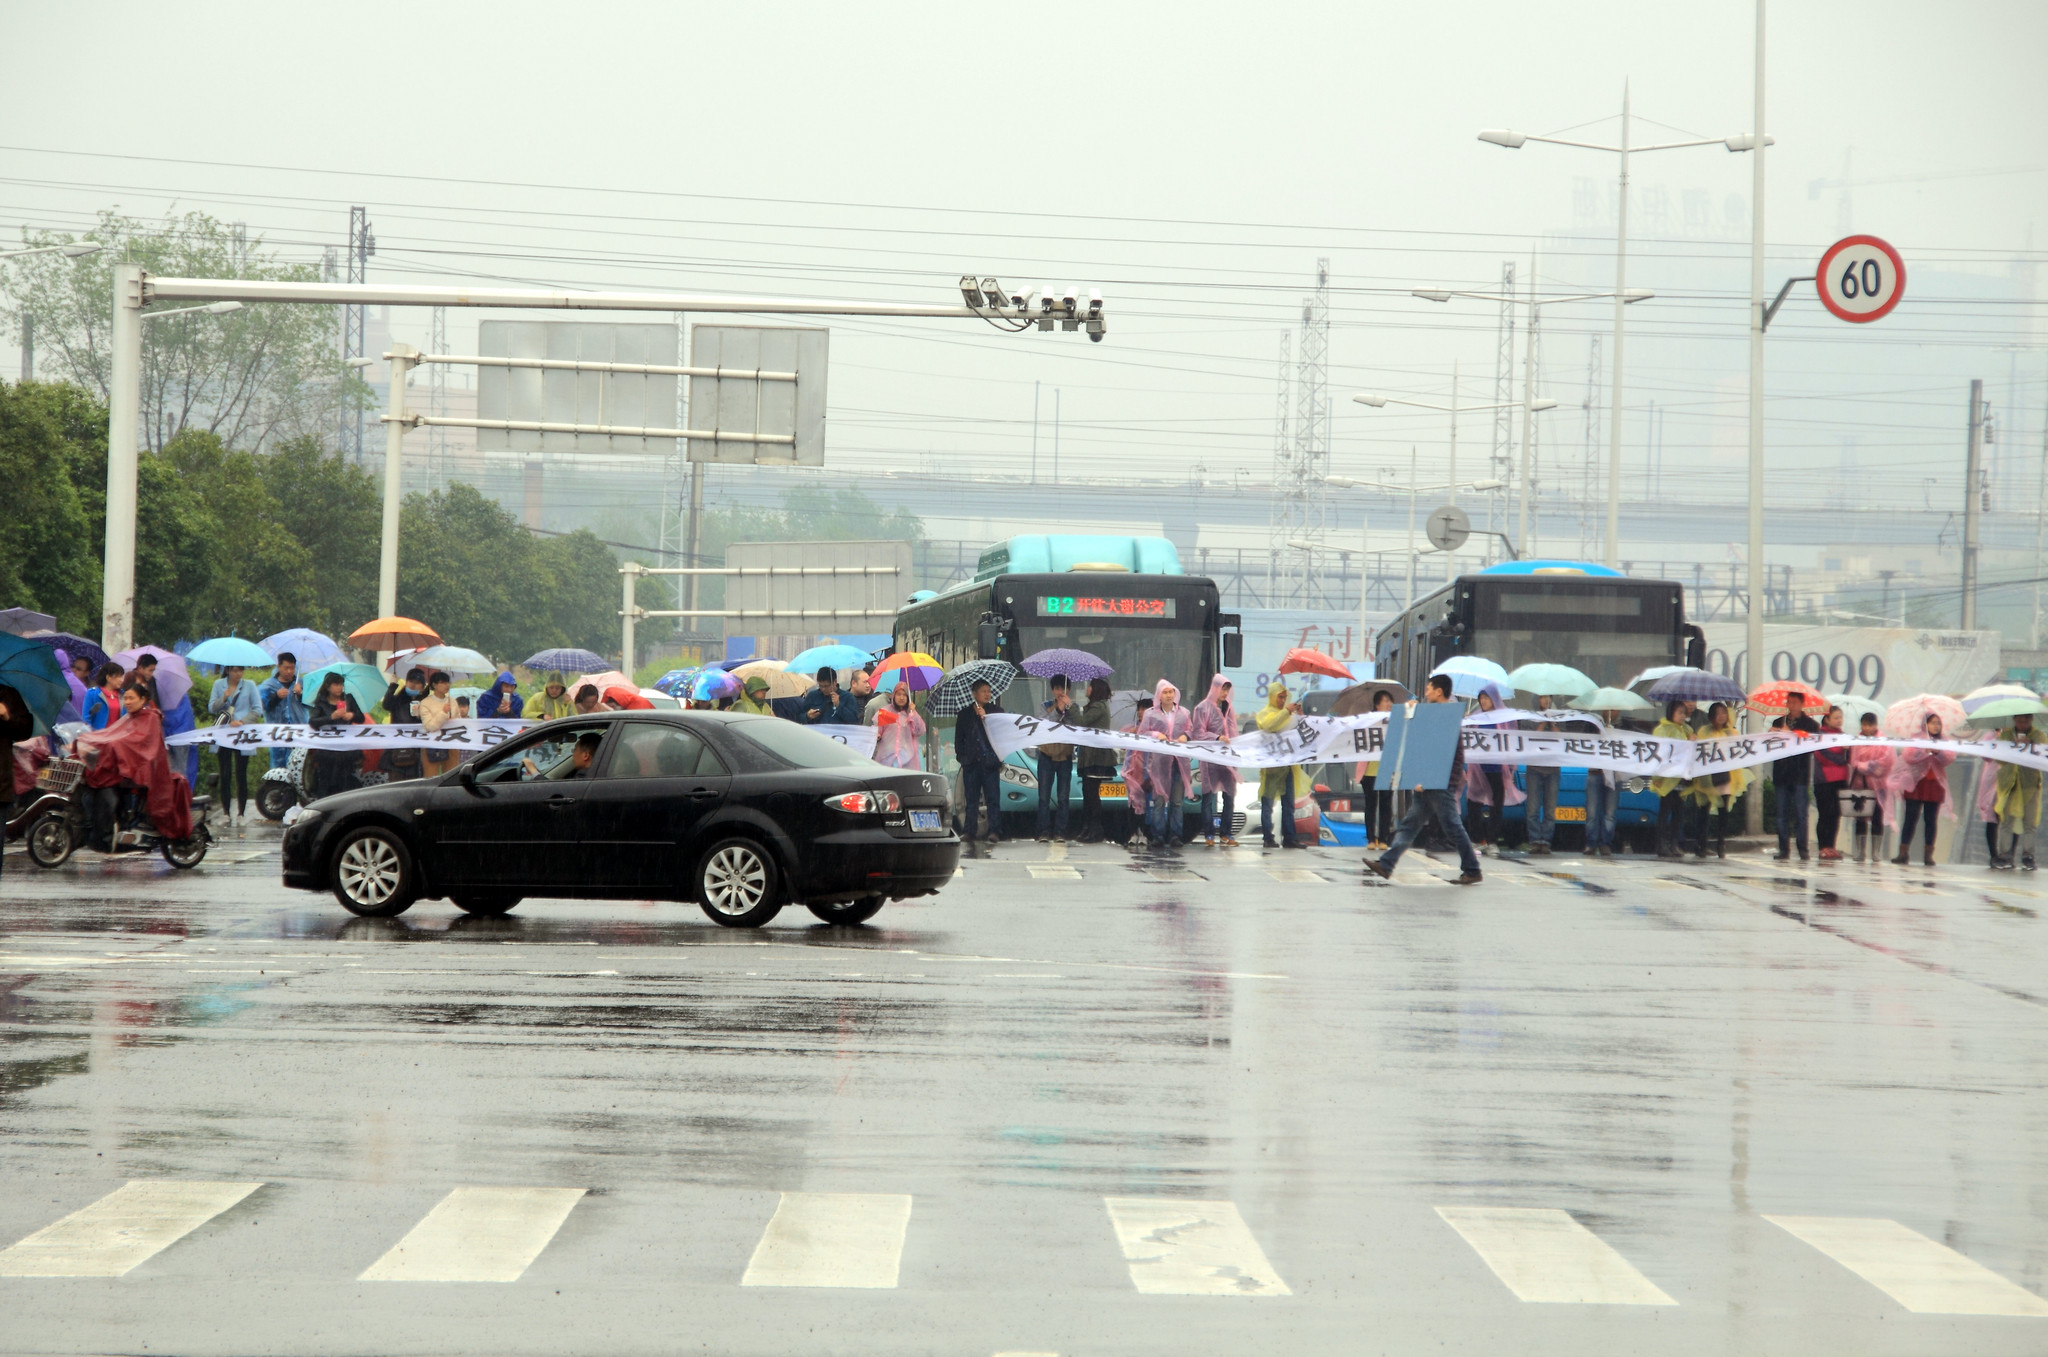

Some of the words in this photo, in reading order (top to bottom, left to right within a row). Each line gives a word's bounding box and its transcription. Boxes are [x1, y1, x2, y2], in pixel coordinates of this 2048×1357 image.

[1841, 258, 1881, 299] 60
[1047, 597, 1074, 613] B2
[1333, 800, 1349, 811] 71
